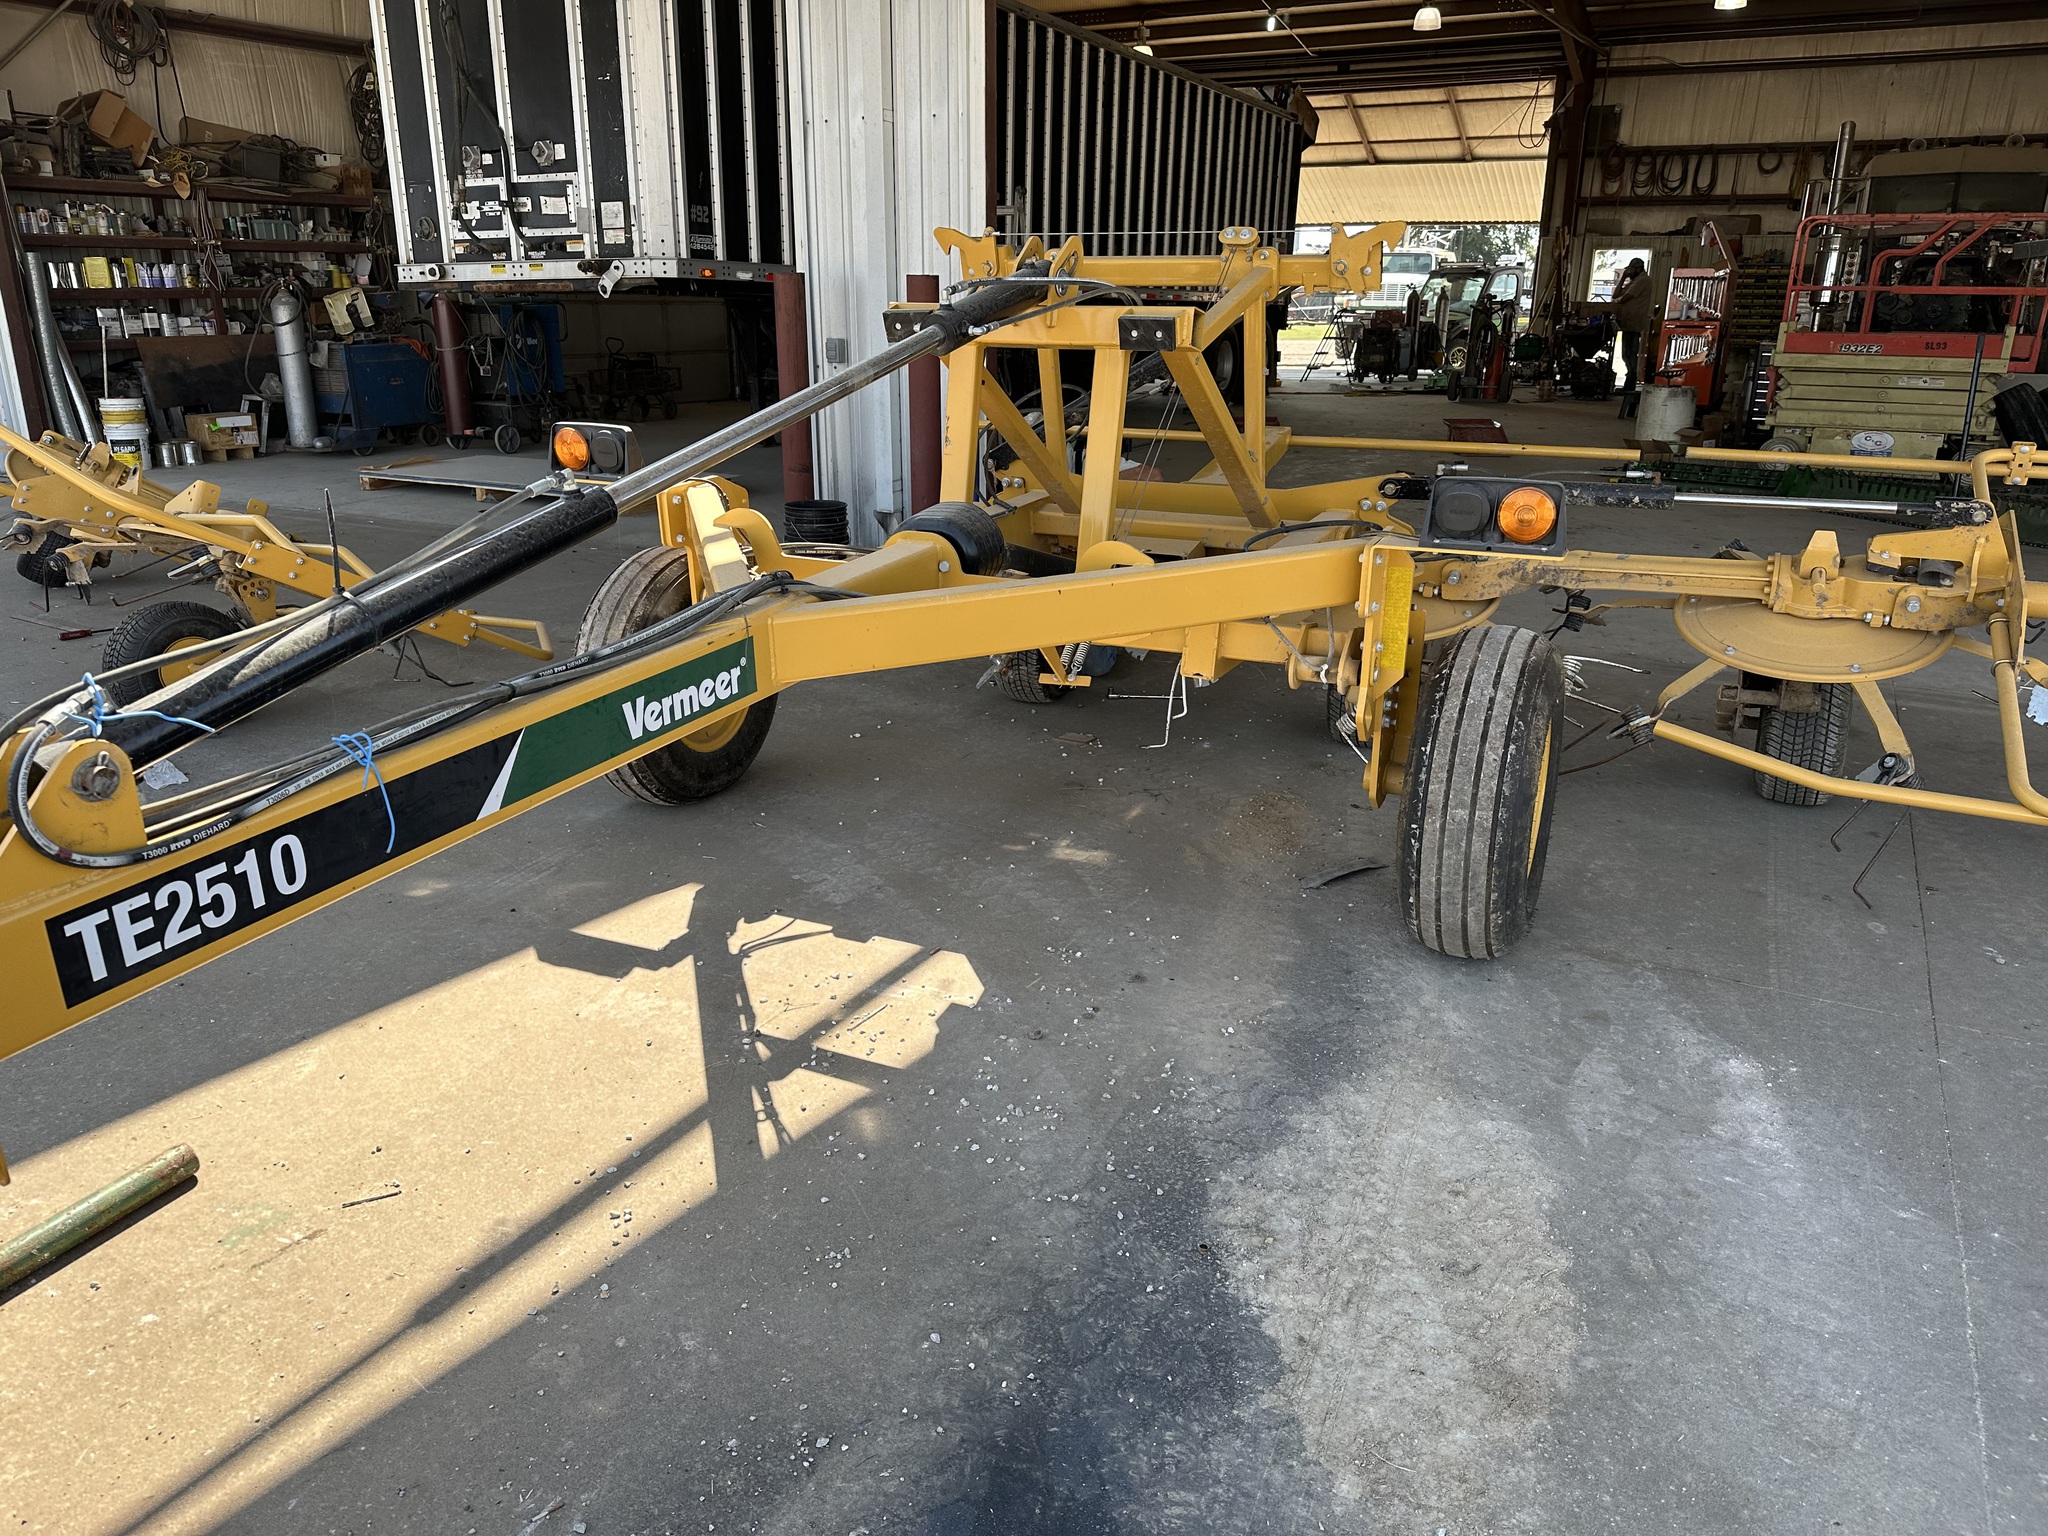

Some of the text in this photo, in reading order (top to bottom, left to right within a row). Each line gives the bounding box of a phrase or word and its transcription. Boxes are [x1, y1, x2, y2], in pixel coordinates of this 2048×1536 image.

[690, 204, 709, 223] #92
[1838, 343, 1884, 354] 1932E2
[142, 845, 168, 860] T3000
[170, 838, 192, 851] RYCO
[266, 789, 290, 805] T3006D
[64, 833, 309, 983] TE2510
